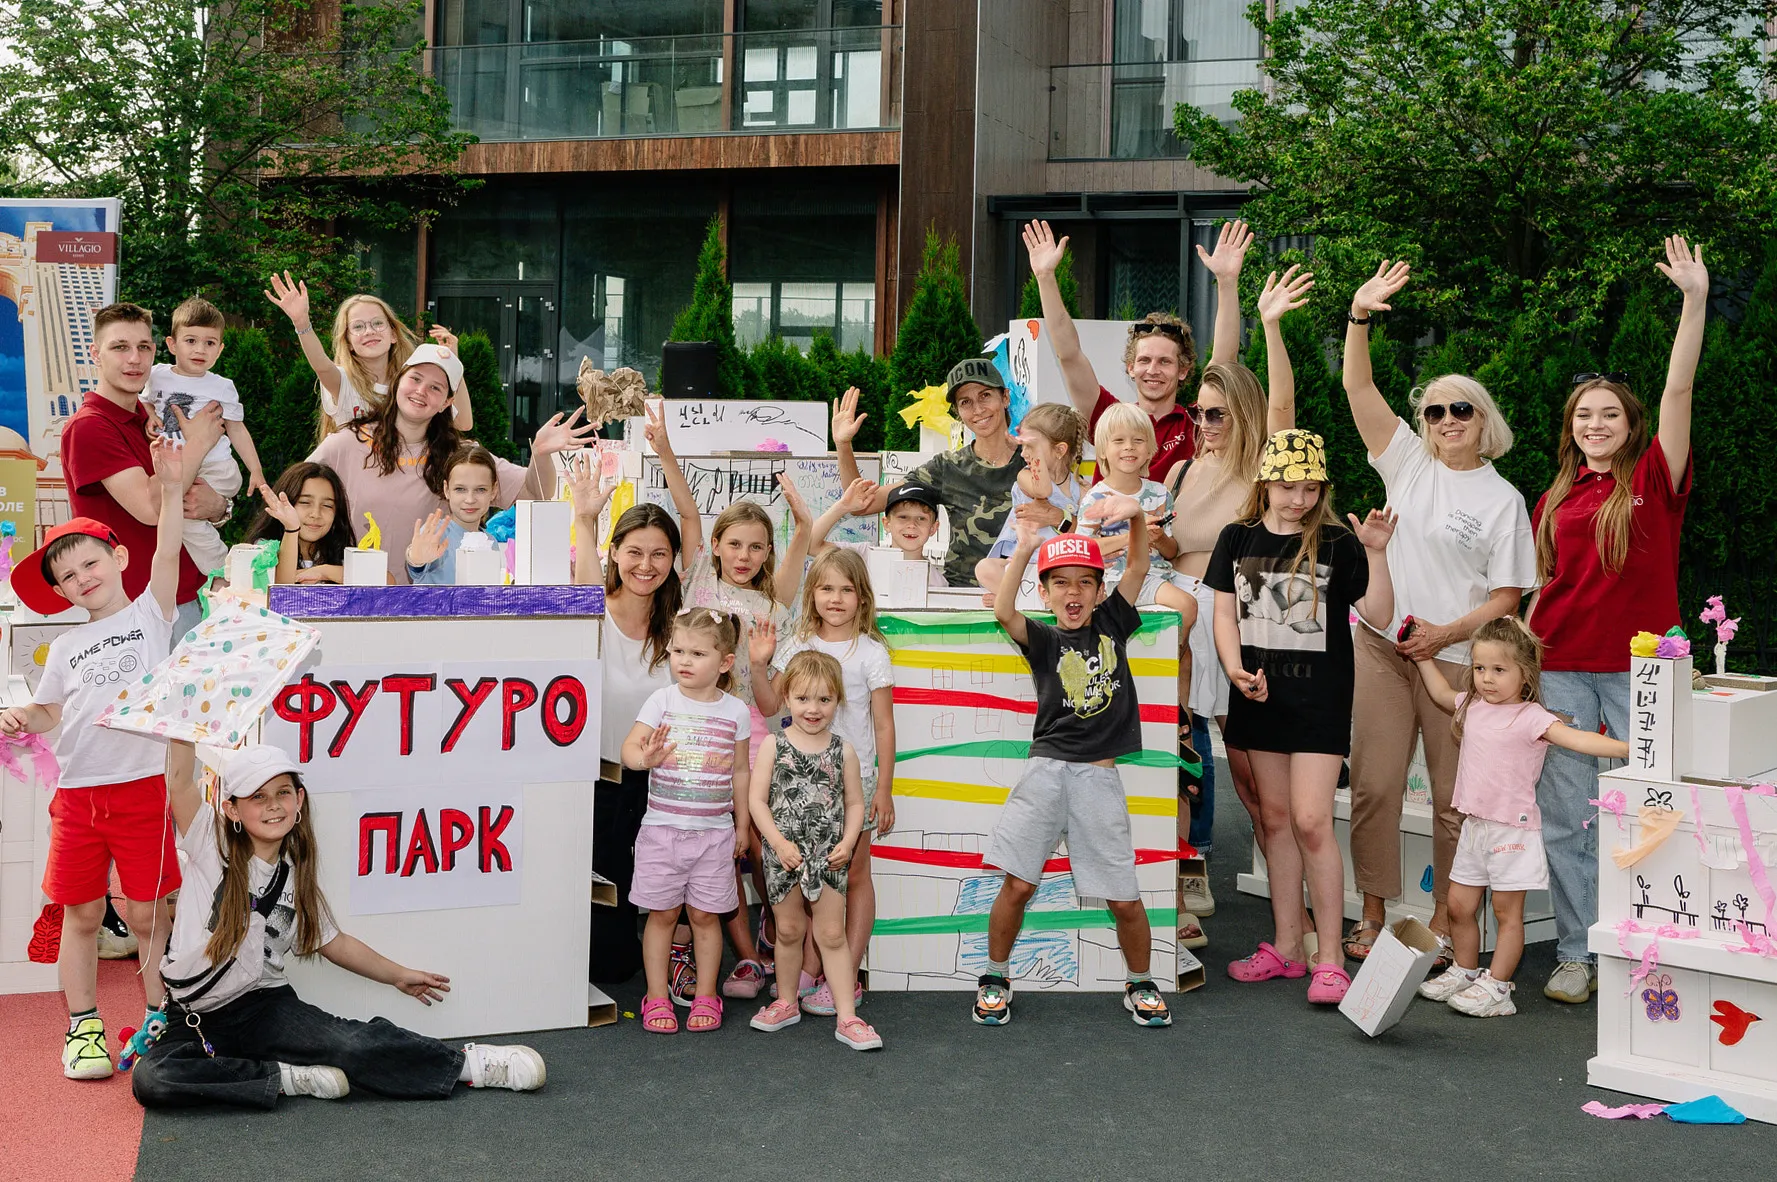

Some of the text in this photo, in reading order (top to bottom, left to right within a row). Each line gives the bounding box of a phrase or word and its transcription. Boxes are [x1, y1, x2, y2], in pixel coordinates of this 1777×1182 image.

[58, 244, 102, 254] VILLAGIO
[950, 362, 989, 386] ICON
[1047, 538, 1091, 560] DIESEL
[69, 628, 144, 669] GAME POWER
[272, 672, 588, 764] ФУТУРО
[358, 805, 514, 877] ПАРК
